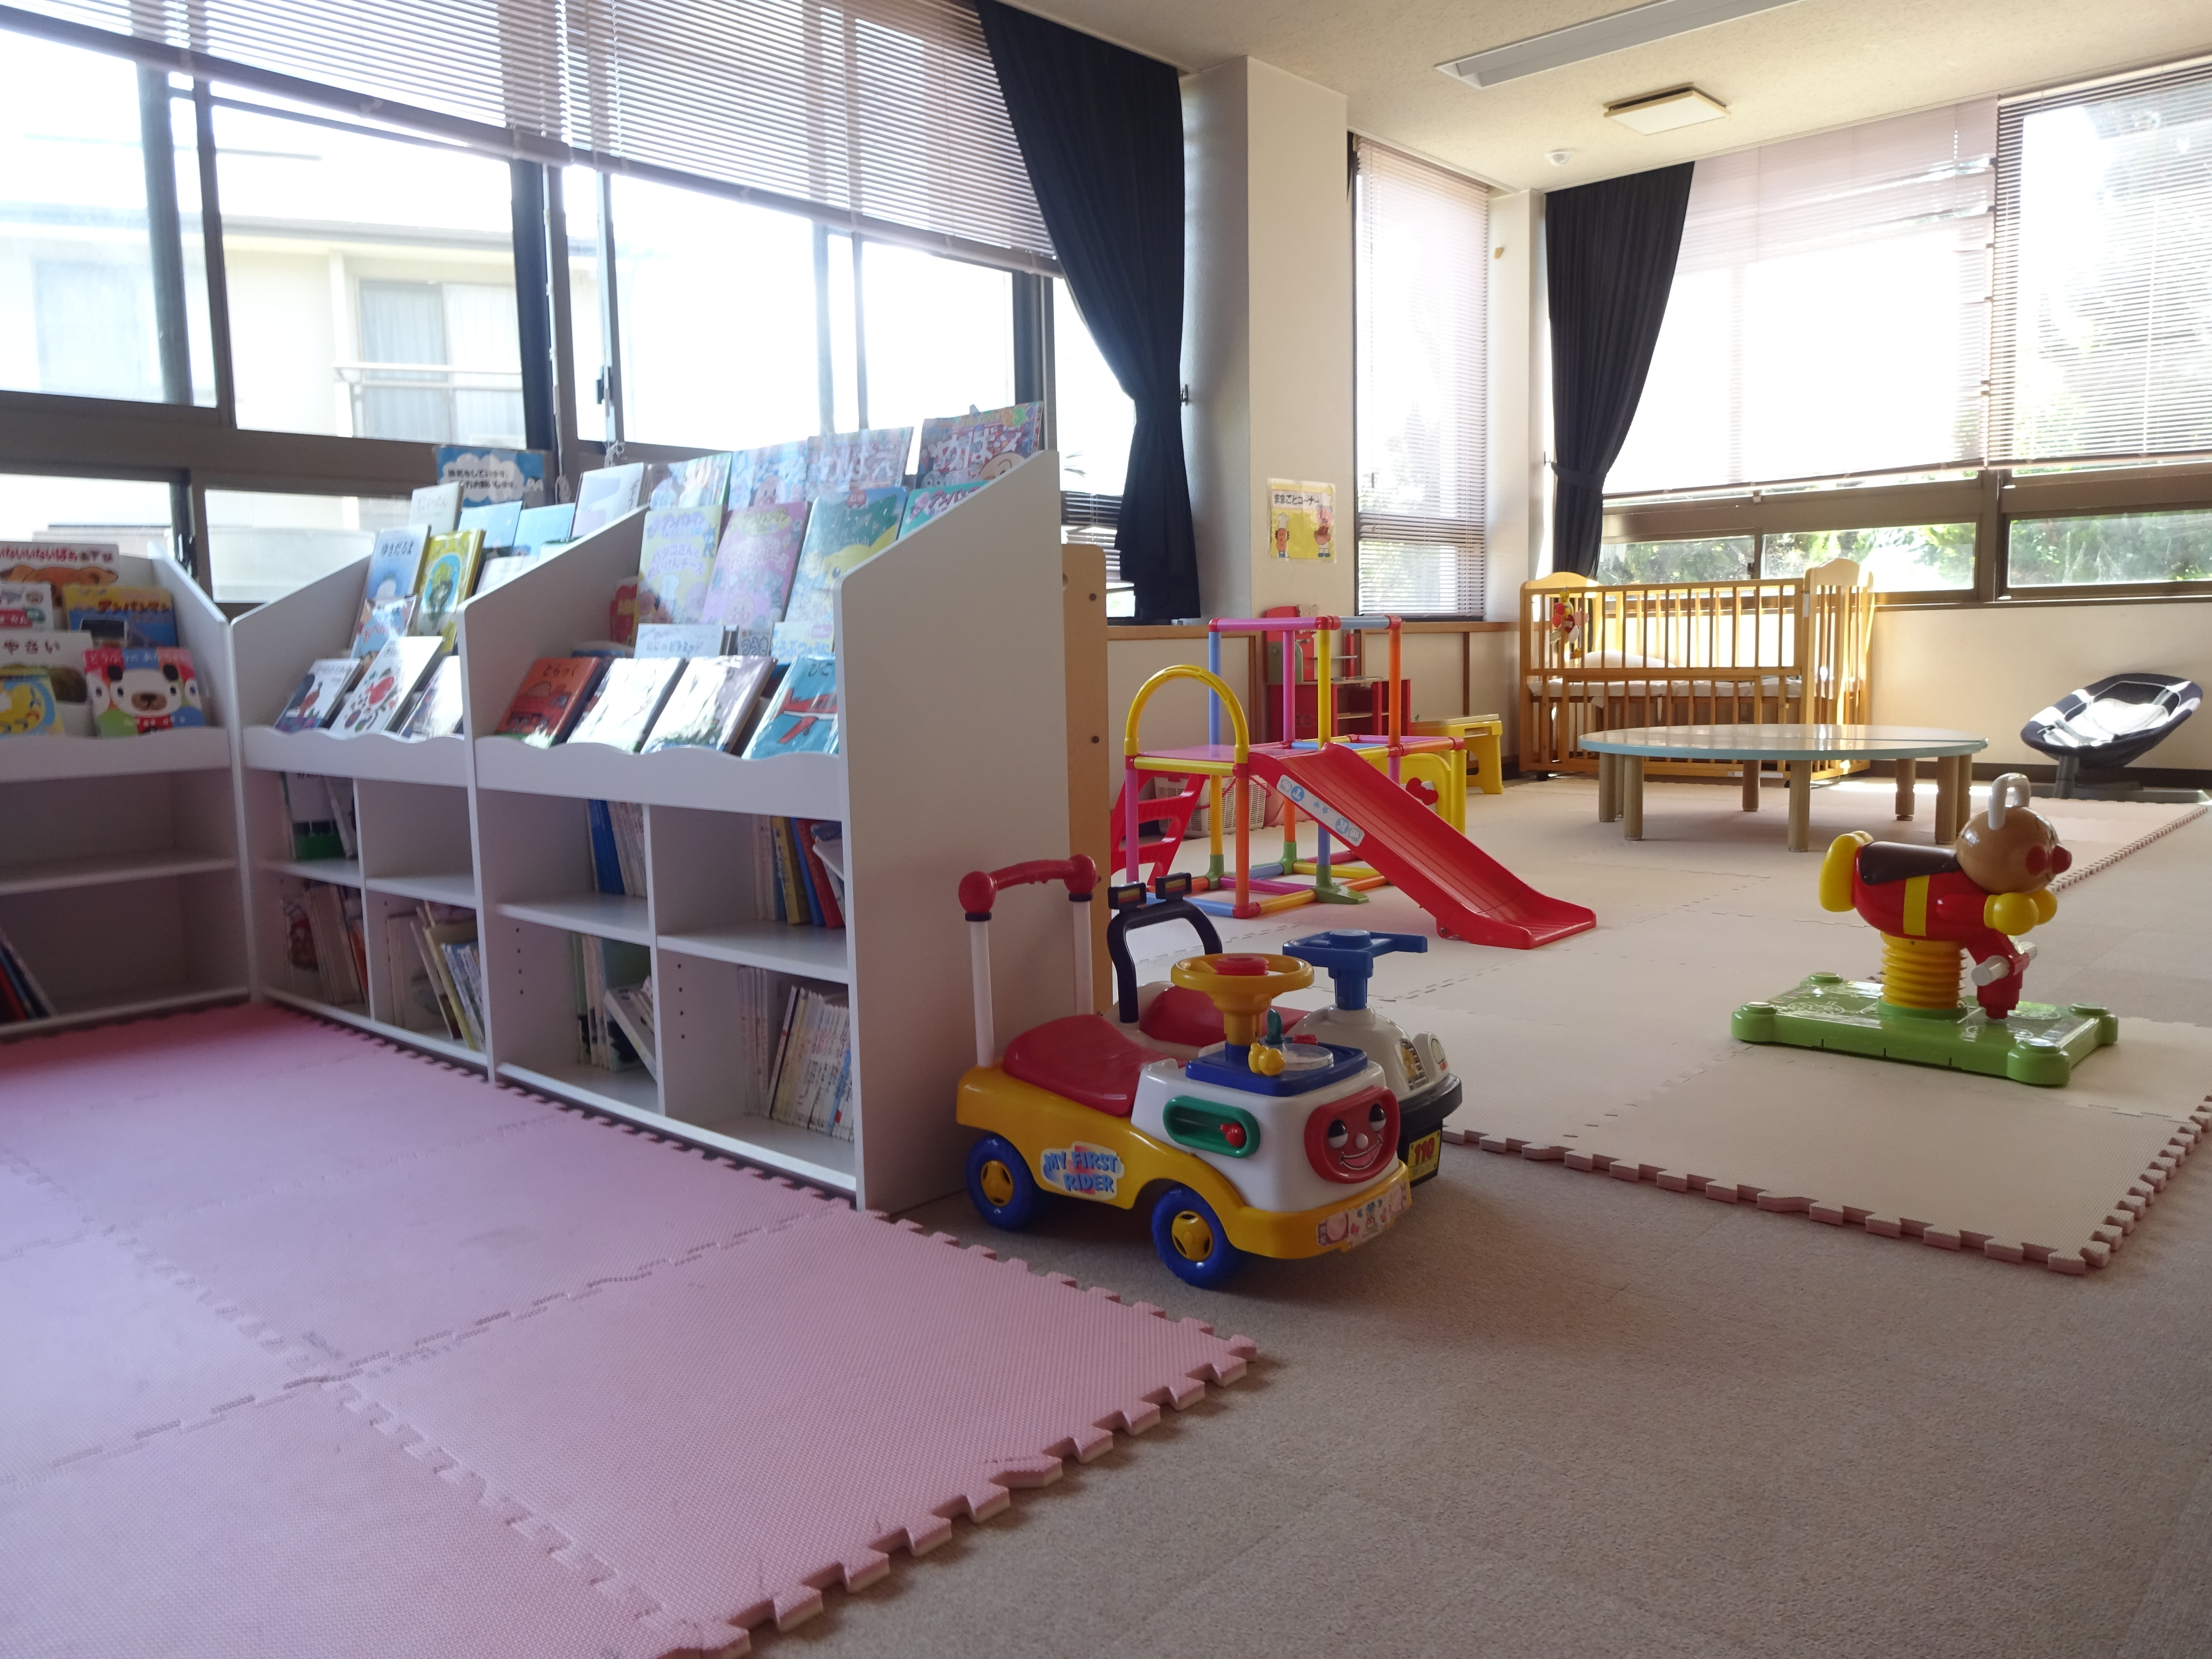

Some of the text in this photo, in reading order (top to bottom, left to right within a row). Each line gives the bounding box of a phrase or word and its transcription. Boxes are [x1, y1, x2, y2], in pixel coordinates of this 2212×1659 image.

[1274, 493, 1319, 506] ままごとコーナー
[381, 540, 414, 557] ゆきだるま
[1415, 1137, 1435, 1165] 110
[1044, 1151, 1118, 1173] MY FIRST
[1063, 1173, 1115, 1194] RIDER
